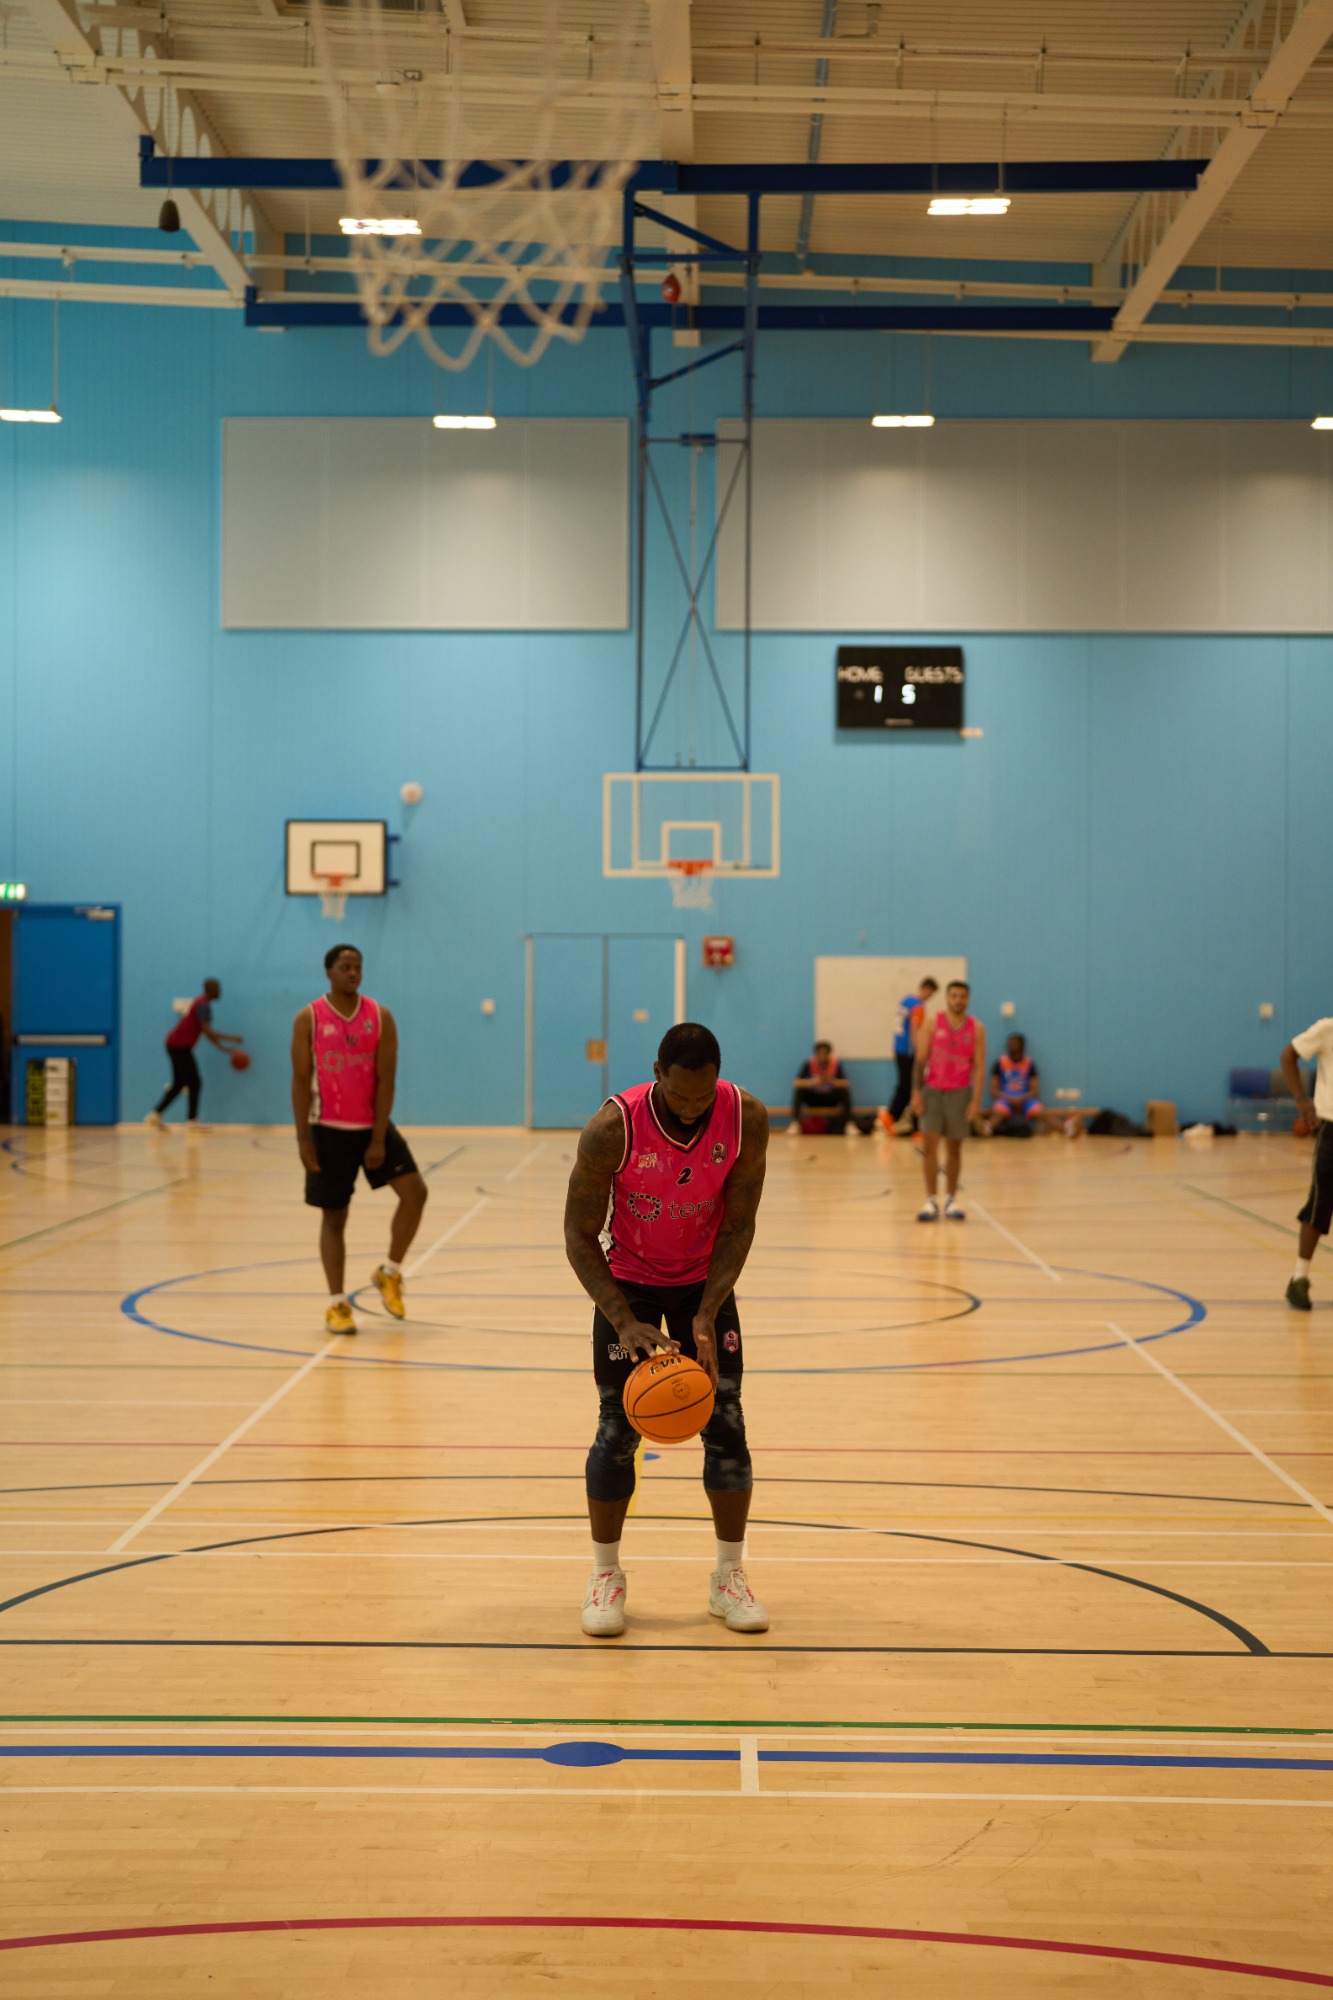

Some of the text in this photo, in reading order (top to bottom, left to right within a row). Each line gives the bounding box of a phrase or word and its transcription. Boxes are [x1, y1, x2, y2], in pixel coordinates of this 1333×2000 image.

[838, 666, 964, 684] HOME GUESTS
[874, 683, 916, 704] 1 5
[677, 1167, 692, 1186] 2
